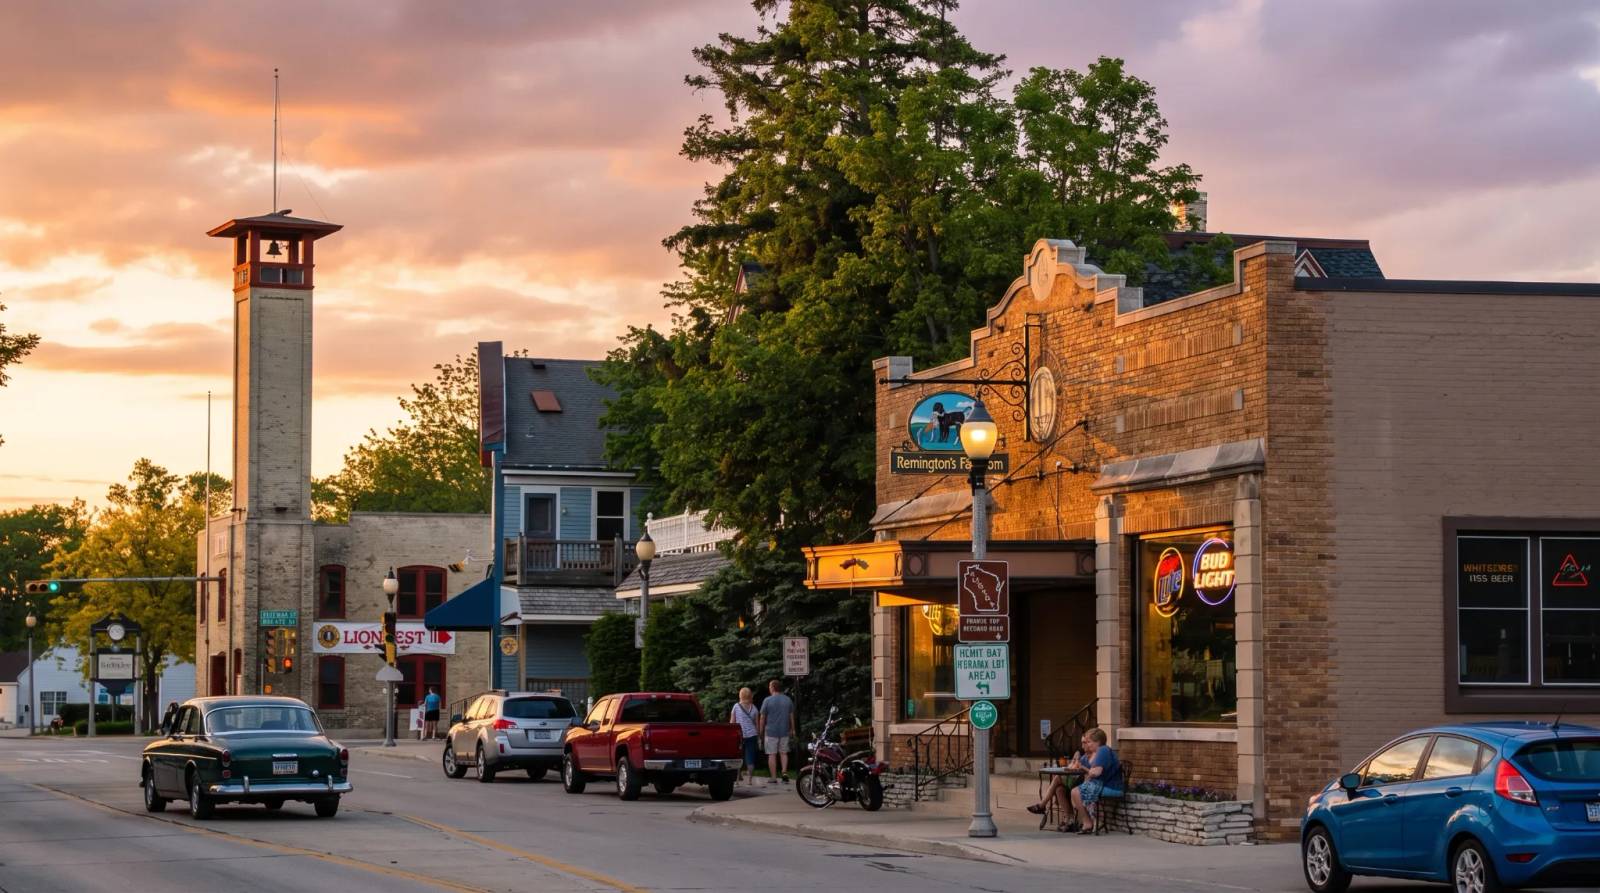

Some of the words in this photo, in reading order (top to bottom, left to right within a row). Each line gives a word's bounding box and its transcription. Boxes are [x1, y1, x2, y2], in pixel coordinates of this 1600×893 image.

[897, 456, 956, 473] Remington's
[960, 457, 1003, 470] Faom
[1201, 552, 1229, 570] BUD
[1194, 570, 1235, 589] LIGHT
[344, 630, 425, 644] LIONEST
